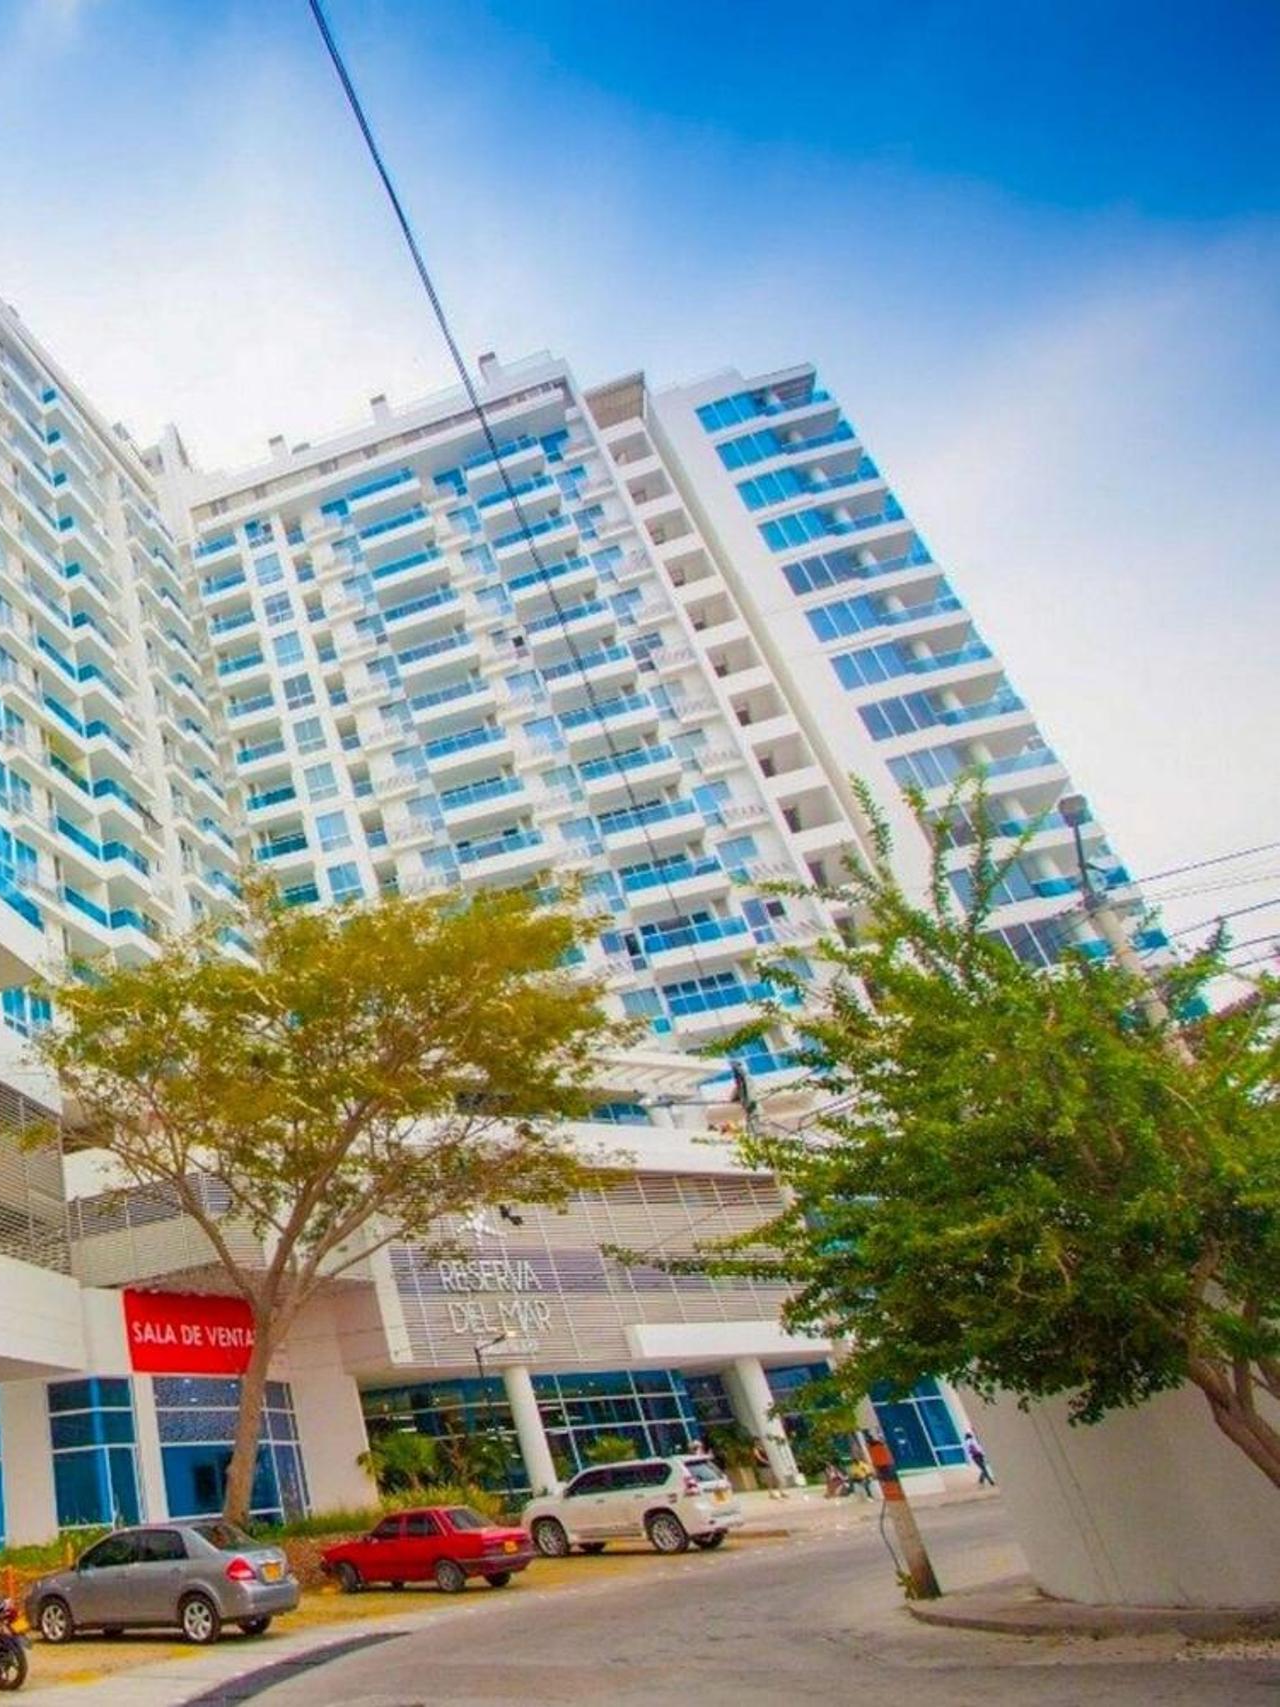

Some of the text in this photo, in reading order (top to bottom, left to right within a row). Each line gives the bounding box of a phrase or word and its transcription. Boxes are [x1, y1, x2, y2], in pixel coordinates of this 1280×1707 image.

[438, 1260, 543, 1291] RESERVA
[448, 1301, 553, 1334] DEL MAR
[131, 1321, 257, 1347] SALA DE VENTA
